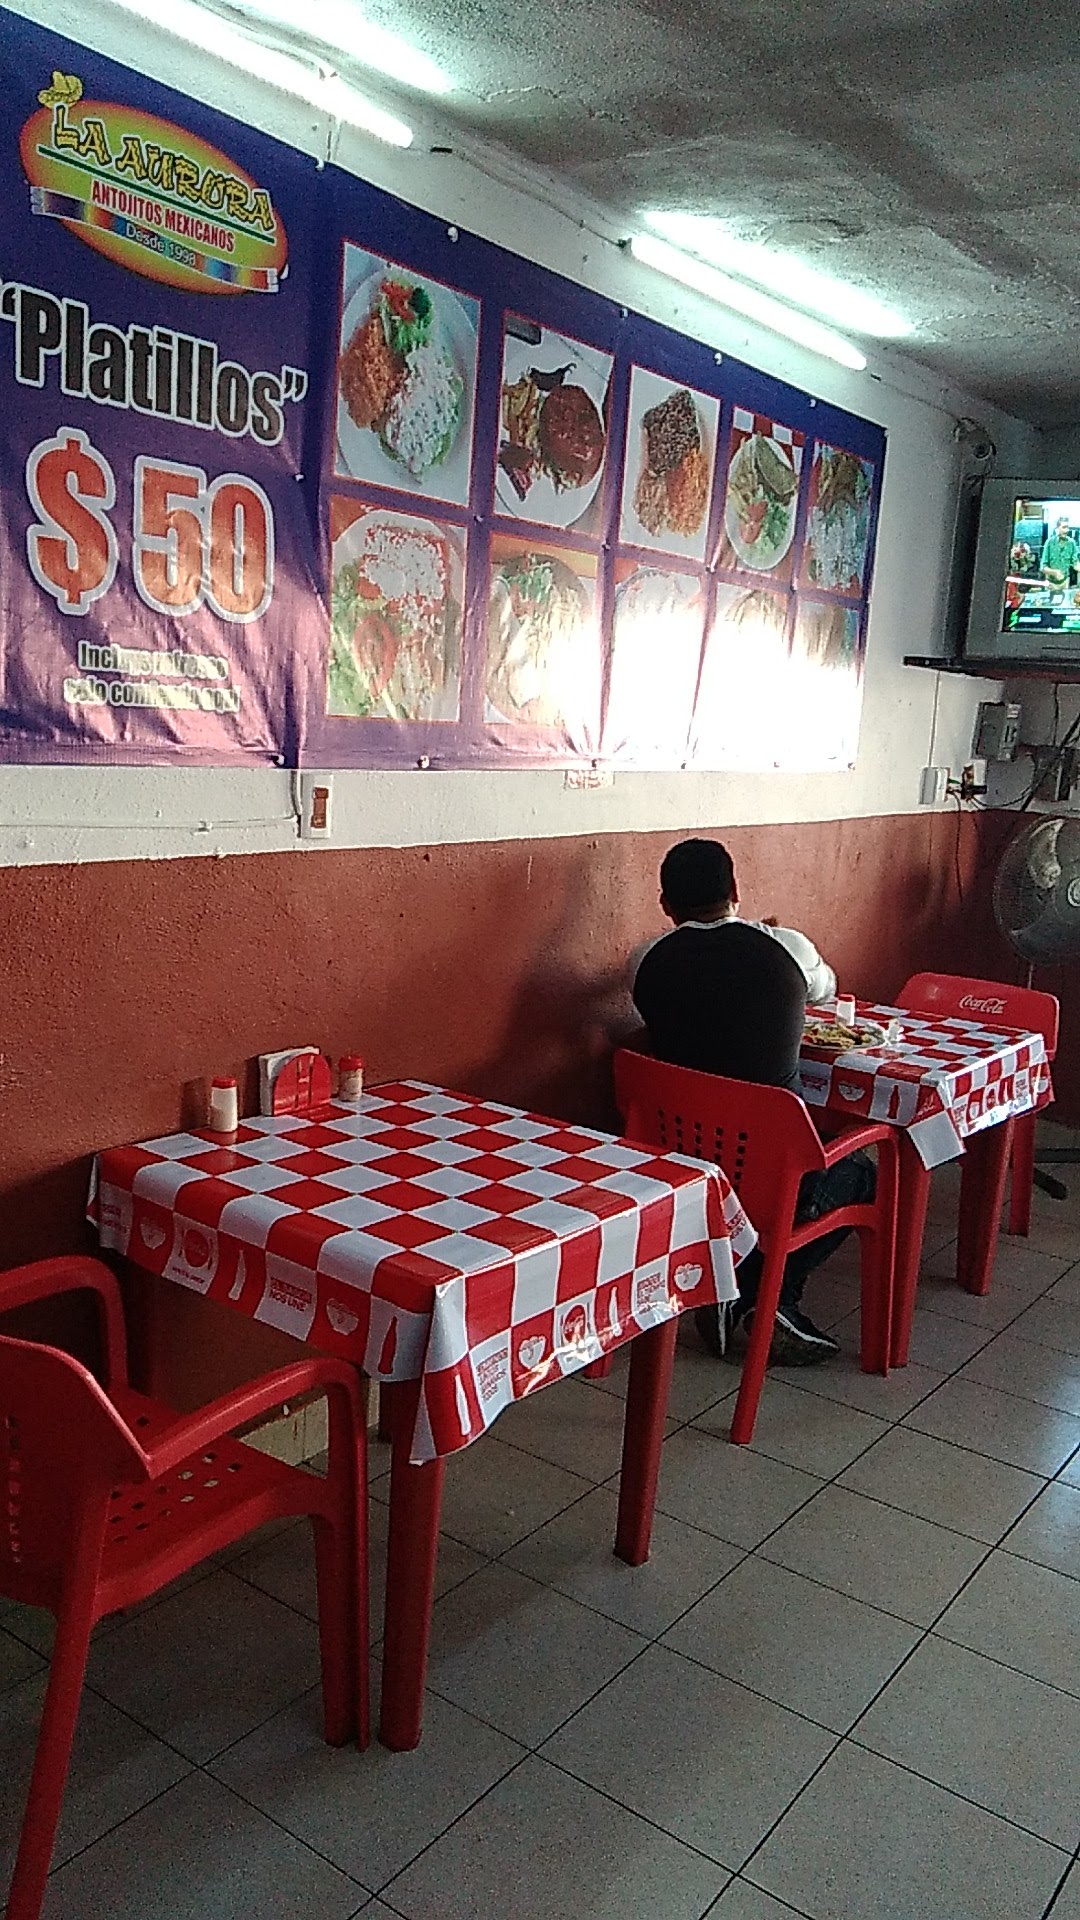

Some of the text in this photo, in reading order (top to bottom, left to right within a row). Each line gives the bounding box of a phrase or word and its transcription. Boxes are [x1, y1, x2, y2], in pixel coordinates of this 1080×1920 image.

[53, 103, 275, 231] LA AURORA
[91, 179, 236, 254] ANTOJITOS MEXICANOS
[125, 221, 165, 253] Desde
[959, 994, 1008, 1014] Coca-Cola
